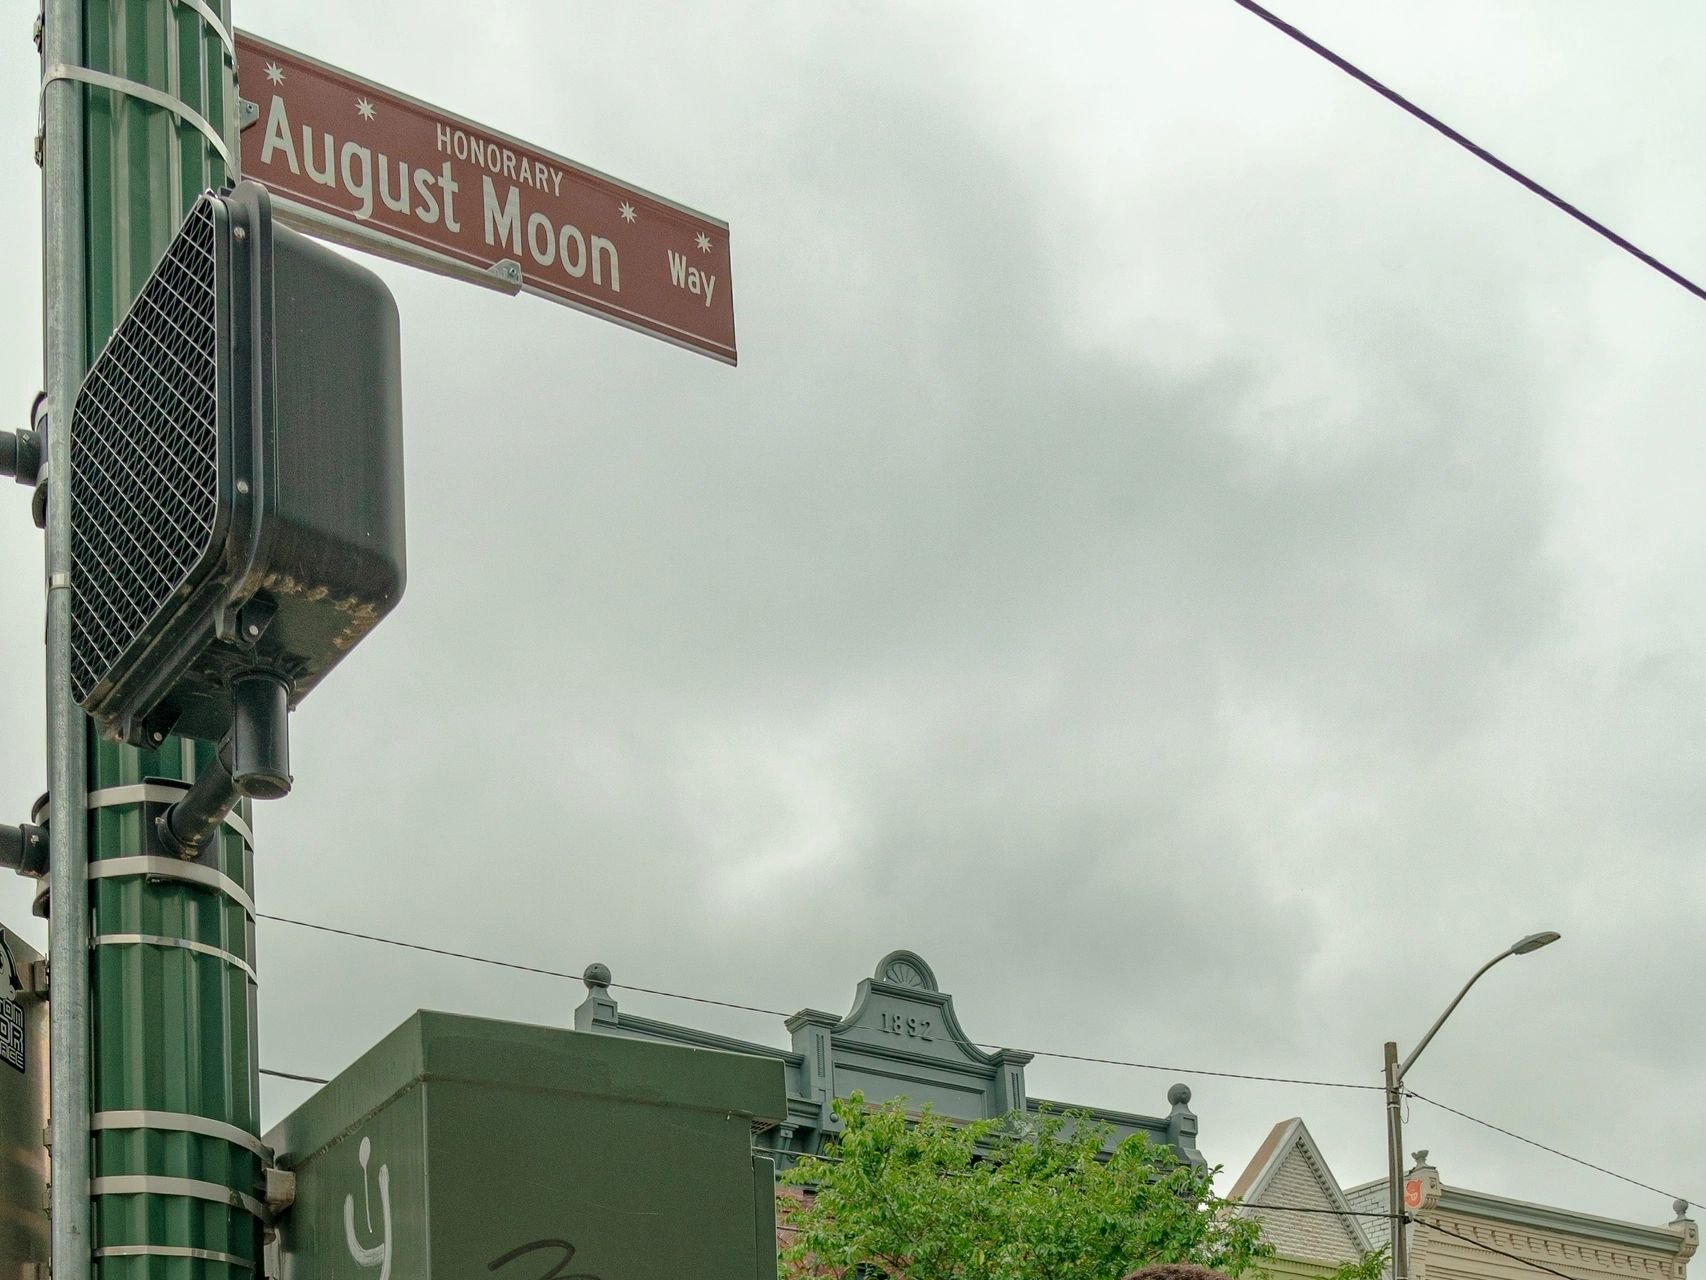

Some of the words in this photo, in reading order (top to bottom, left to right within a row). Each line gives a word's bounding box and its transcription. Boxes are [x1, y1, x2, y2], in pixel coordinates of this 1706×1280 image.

[436, 122, 563, 197] HONORARY
[260, 95, 460, 233] August
[482, 175, 621, 292] Moon
[668, 249, 716, 307] Way
[881, 1013, 933, 1042] 1892
